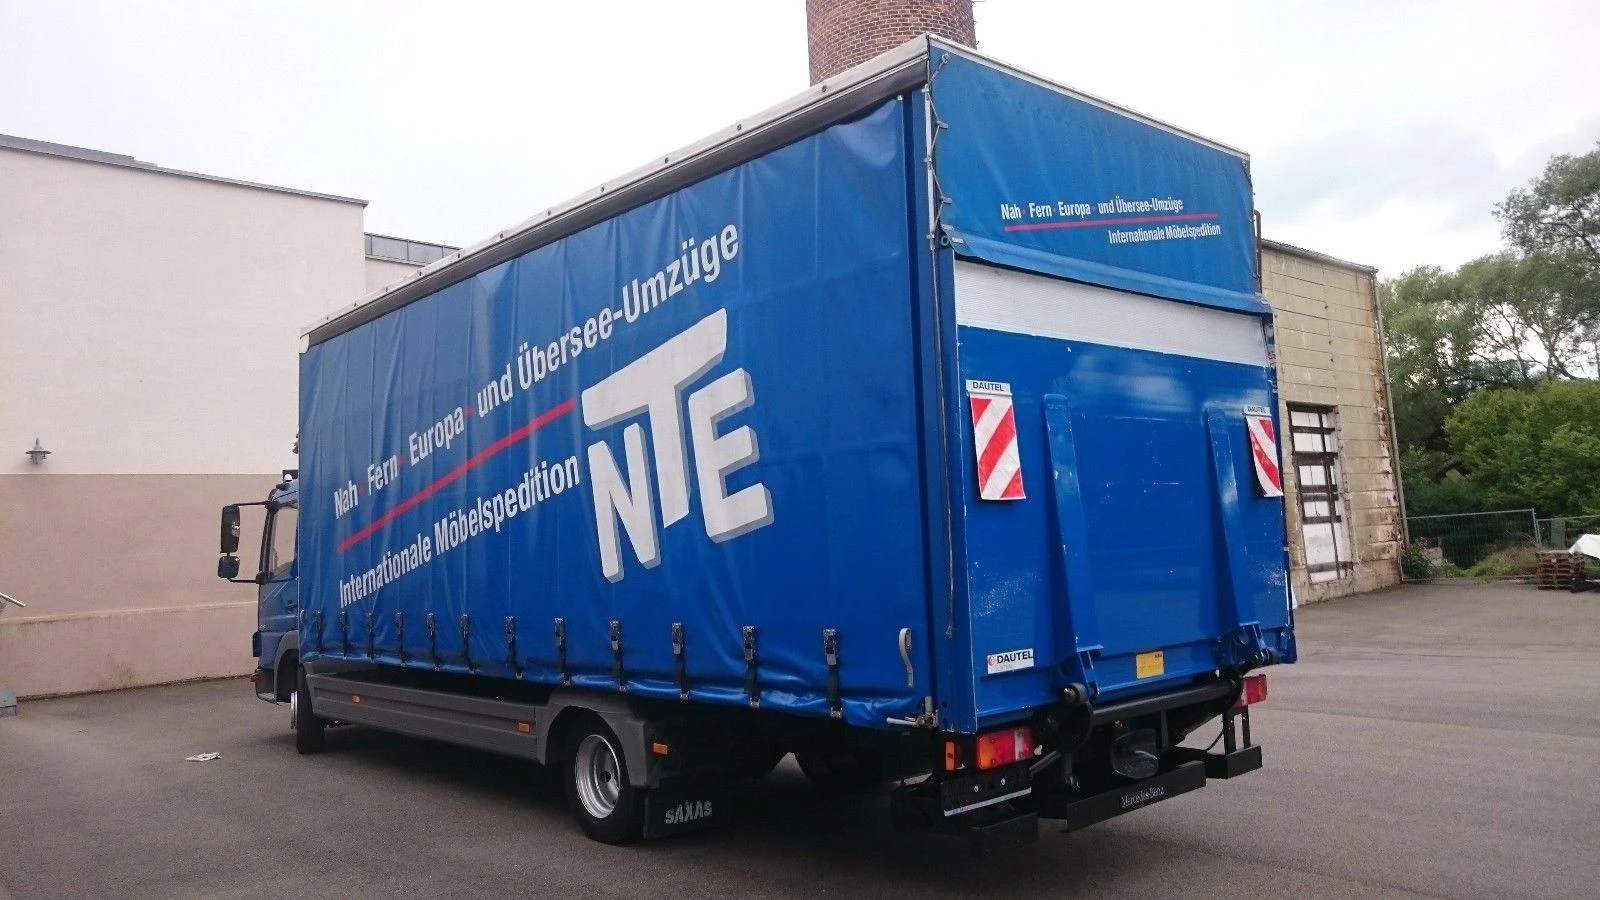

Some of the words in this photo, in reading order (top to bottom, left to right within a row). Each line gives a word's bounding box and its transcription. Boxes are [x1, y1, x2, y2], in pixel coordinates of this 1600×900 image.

[1001, 203, 1022, 220] Nah
[1029, 202, 1053, 218] Fern
[1058, 201, 1091, 218] Europa
[1098, 199, 1114, 214] und
[1115, 196, 1184, 213] Übersee-Umzüge
[1109, 226, 1165, 244] Internationale
[1165, 223, 1221, 240] Möbelspedition
[334, 480, 359, 519] Nah
[367, 454, 398, 496] Fern
[408, 406, 465, 466] Europa
[477, 363, 514, 418] und
[517, 224, 739, 390] Übersee-Umzüge
[972, 381, 1005, 392] DAUTEL
[581, 308, 774, 583] NTE
[339, 533, 432, 609] Internationale
[434, 455, 580, 555] Möbelspedition
[997, 650, 1033, 664] DAUTEL
[665, 800, 713, 824] SAXAS
